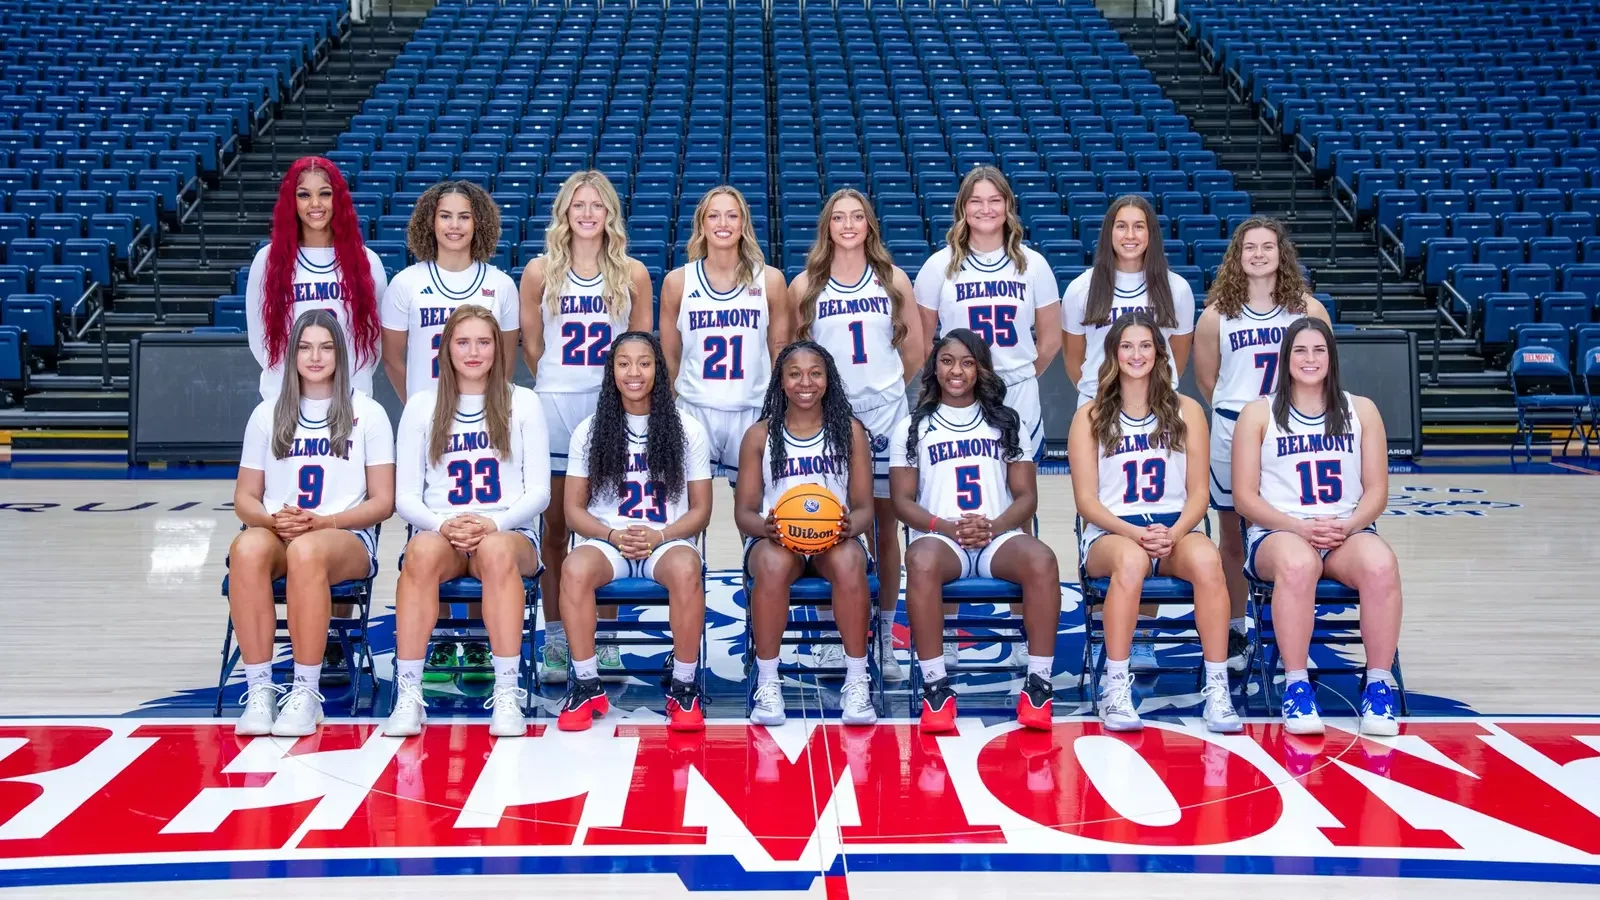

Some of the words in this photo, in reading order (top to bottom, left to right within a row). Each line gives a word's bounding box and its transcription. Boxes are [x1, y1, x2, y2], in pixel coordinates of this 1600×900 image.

[294, 281, 346, 301] ELMO
[818, 296, 890, 320] BELMONT
[955, 281, 1026, 302] BELMONT
[689, 308, 761, 331] BELMONT
[968, 305, 1018, 347] 55
[562, 322, 612, 365] 22
[703, 335, 744, 380] 21
[849, 321, 868, 364] 1
[1254, 352, 1279, 395] 7
[928, 438, 1001, 465] BELMONT
[1276, 433, 1354, 457] BELMONT
[297, 465, 325, 509] 9
[447, 458, 502, 505] 33
[618, 480, 667, 523] 23
[955, 464, 983, 511] 5
[1123, 457, 1166, 504] 13
[1296, 459, 1342, 505] 15
[788, 524, 834, 539] Wilson
